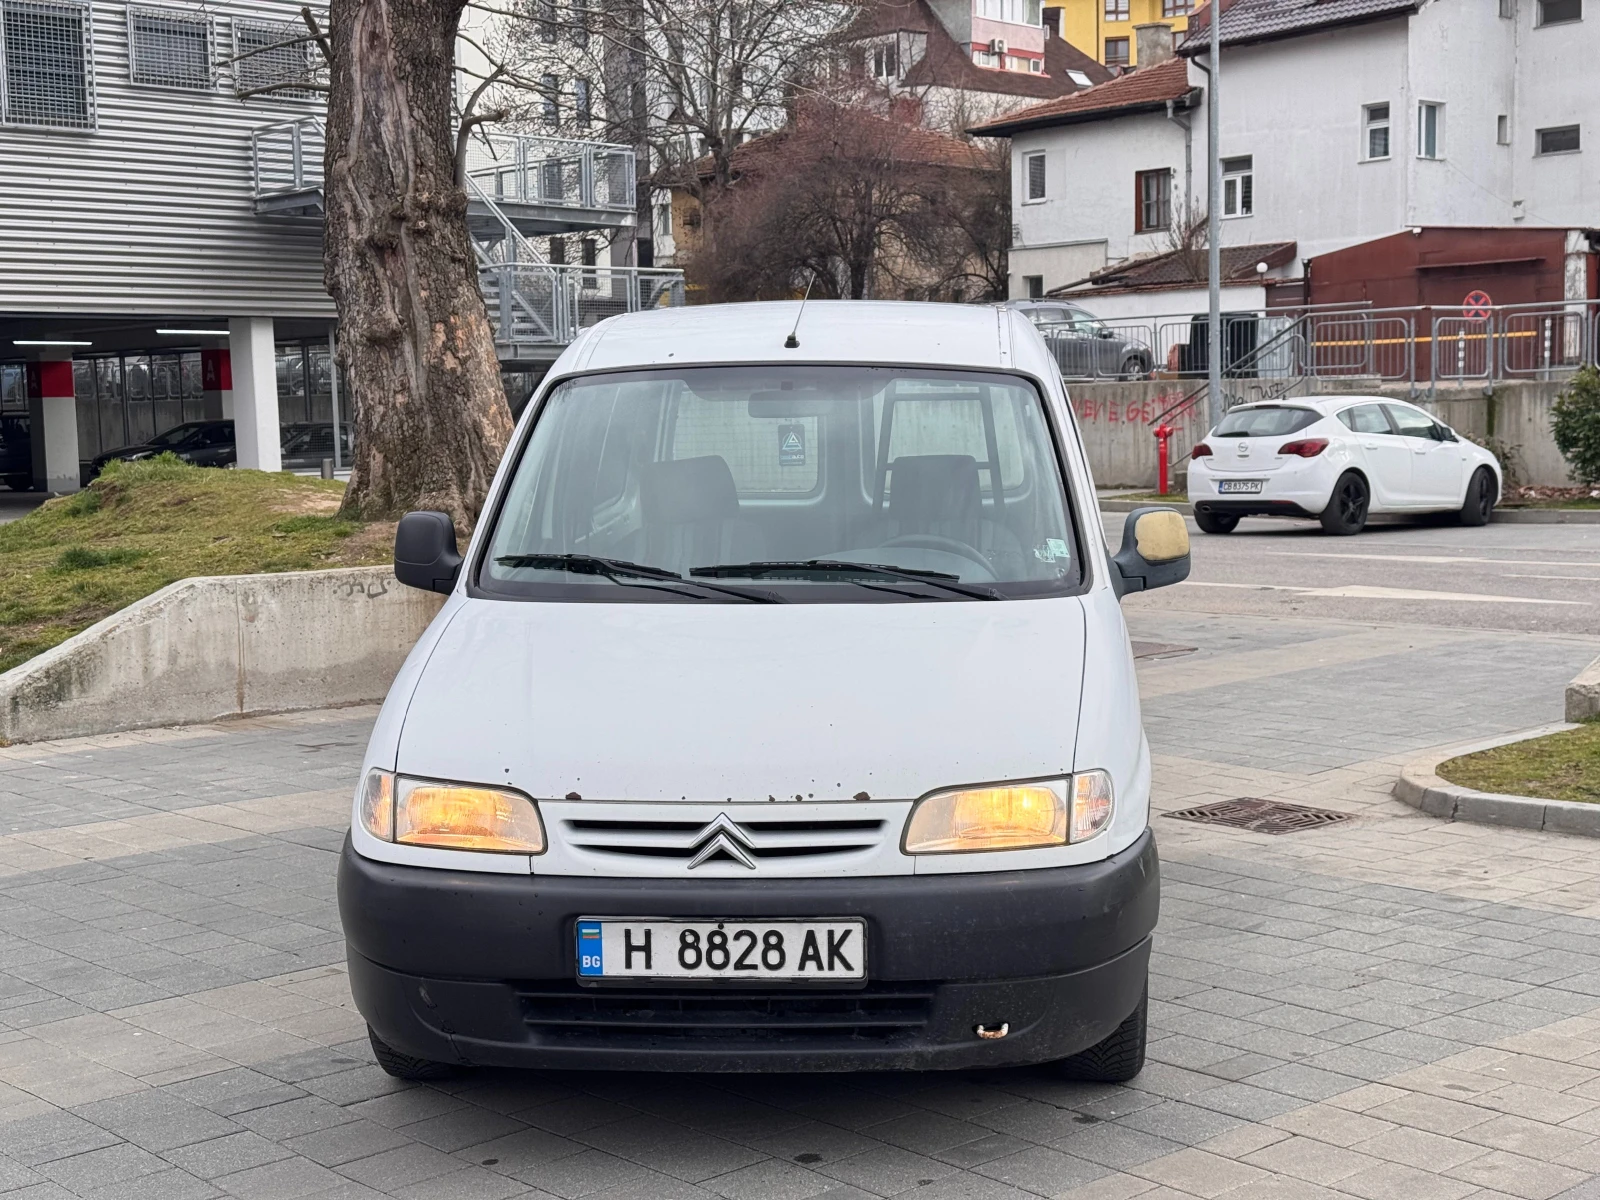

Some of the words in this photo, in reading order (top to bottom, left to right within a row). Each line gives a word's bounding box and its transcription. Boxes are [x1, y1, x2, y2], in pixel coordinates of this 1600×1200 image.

[206, 359, 216, 381] A
[1223, 482, 1233, 491] CB
[1232, 482, 1250, 491] 8375
[1250, 482, 1261, 491] PK
[624, 928, 652, 970] H
[678, 928, 786, 970] 8828
[798, 929, 855, 972] AK
[582, 955, 601, 968] BG
